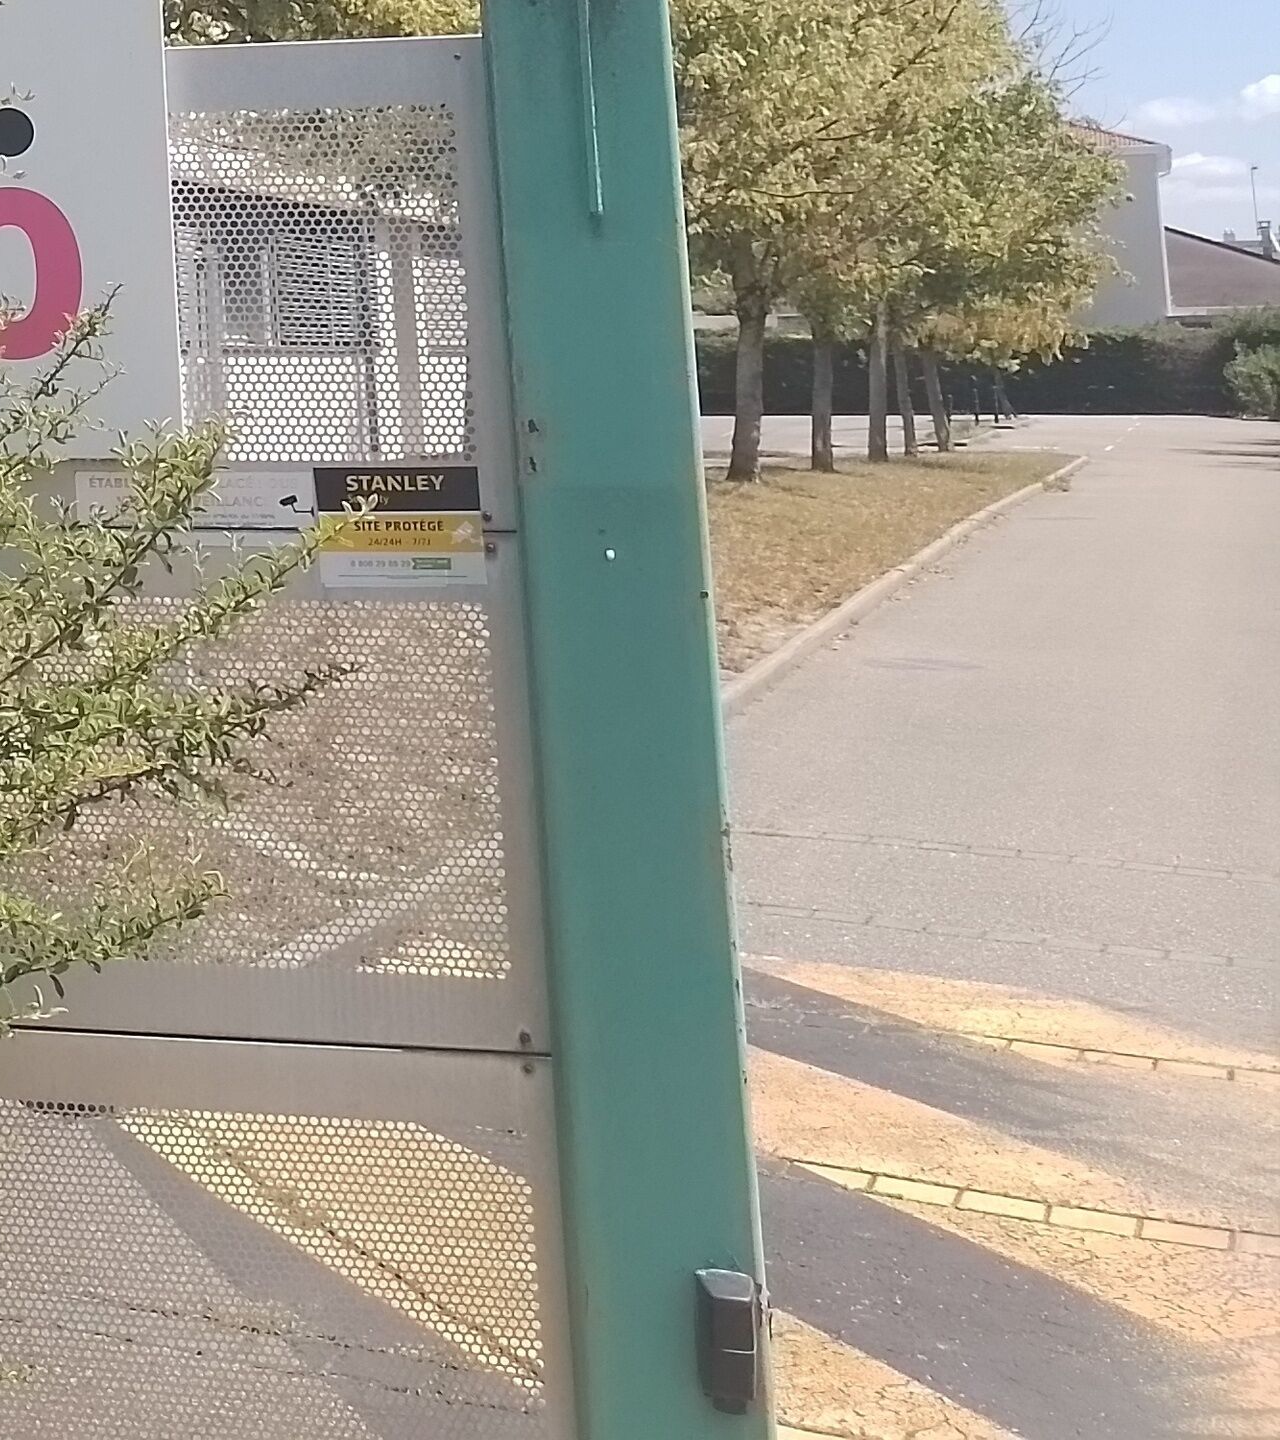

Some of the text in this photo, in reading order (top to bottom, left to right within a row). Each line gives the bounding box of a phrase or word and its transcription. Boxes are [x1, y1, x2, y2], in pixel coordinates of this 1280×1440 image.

[345, 474, 445, 492] STANLEY
[353, 520, 383, 532] SITE
[368, 537, 402, 547] 24/24H
